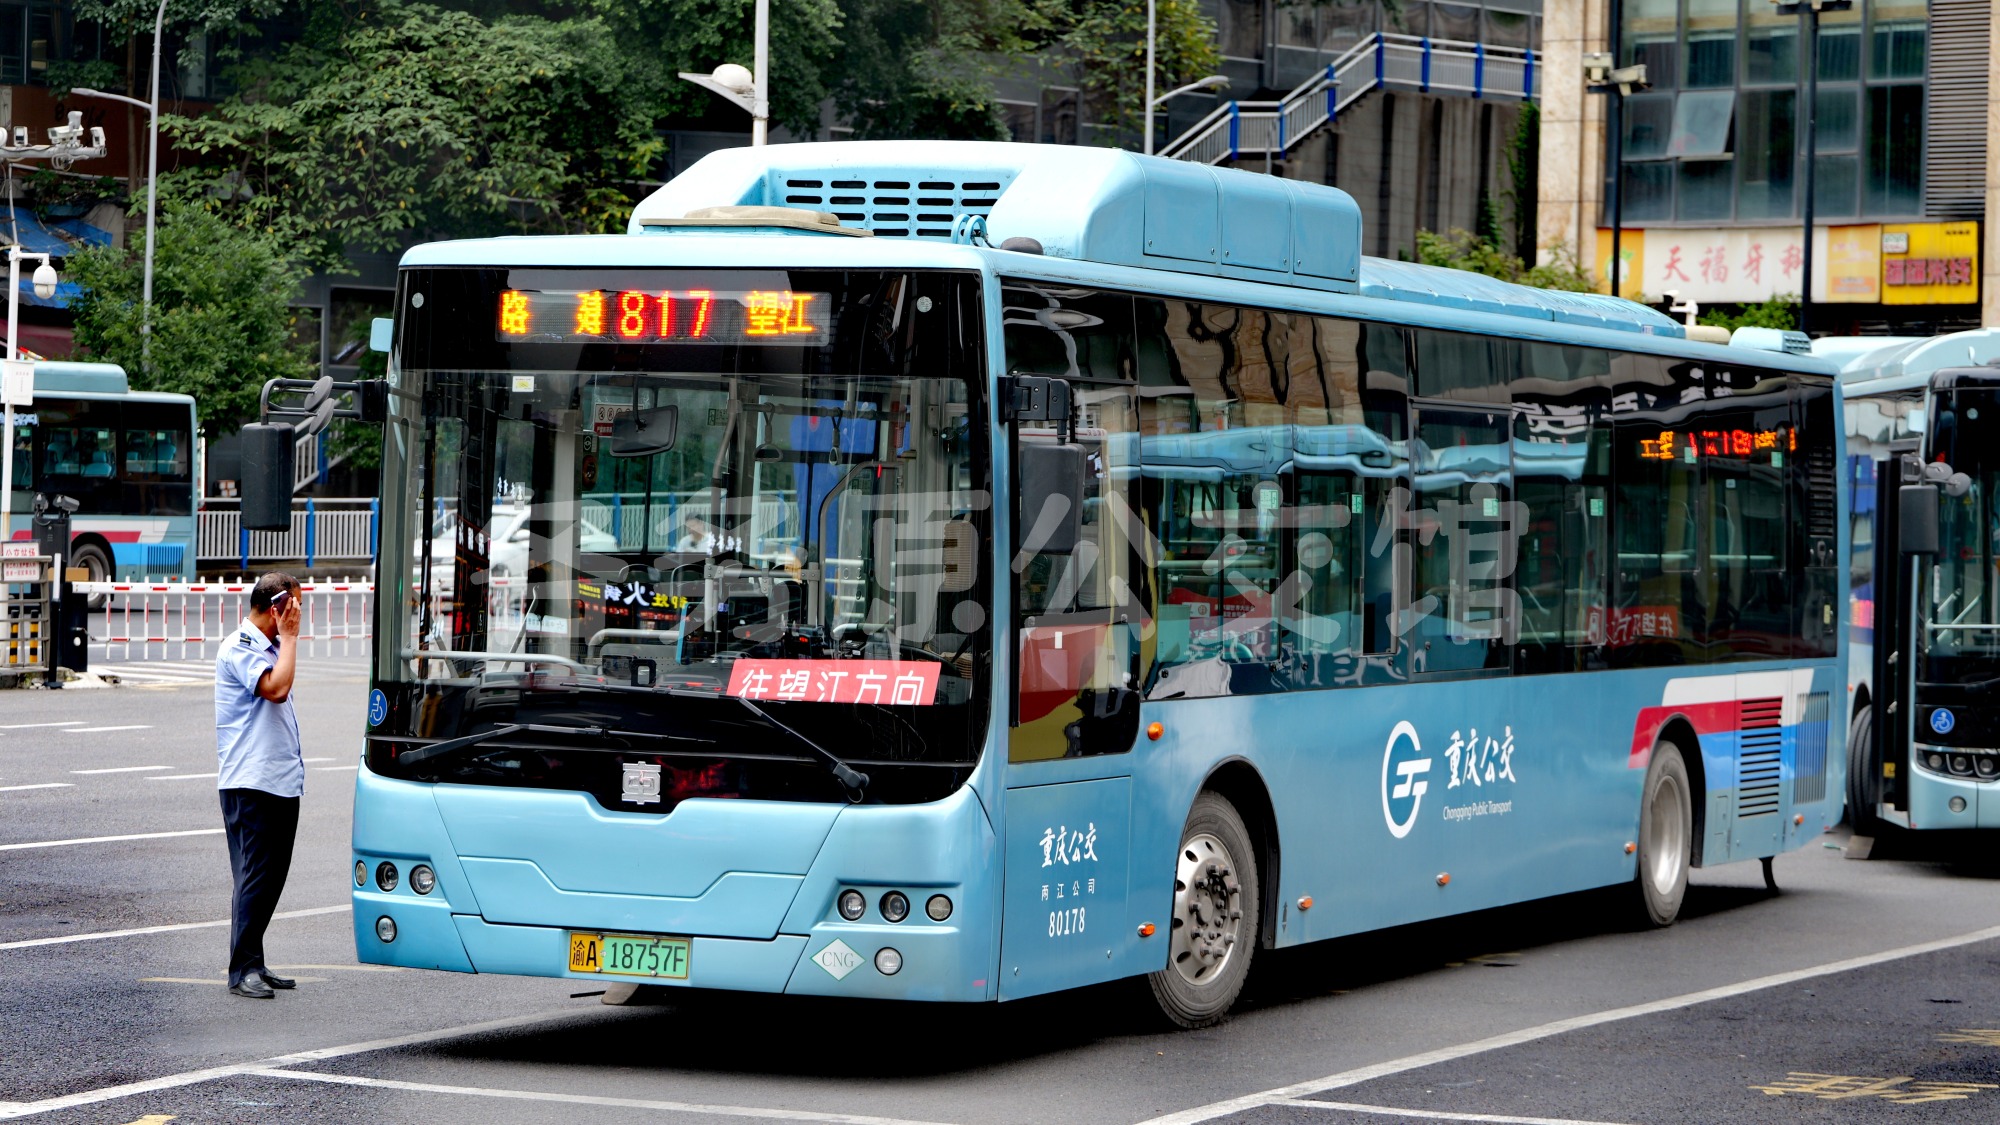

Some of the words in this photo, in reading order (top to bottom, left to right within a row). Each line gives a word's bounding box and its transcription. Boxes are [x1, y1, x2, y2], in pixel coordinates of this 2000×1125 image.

[1662, 243, 1803, 285] 天福牙科
[619, 290, 711, 337] 817
[746, 290, 813, 334] 望江
[738, 668, 926, 705] 往望江方向
[1444, 725, 1516, 790] 重庆公交
[1472, 801, 1488, 816] Public
[1488, 800, 1512, 816] Transport
[1039, 822, 1098, 868] 重庆公交
[1041, 878, 1095, 901] 两江公司
[1048, 907, 1086, 938] 80178
[821, 951, 855, 967] CNG
